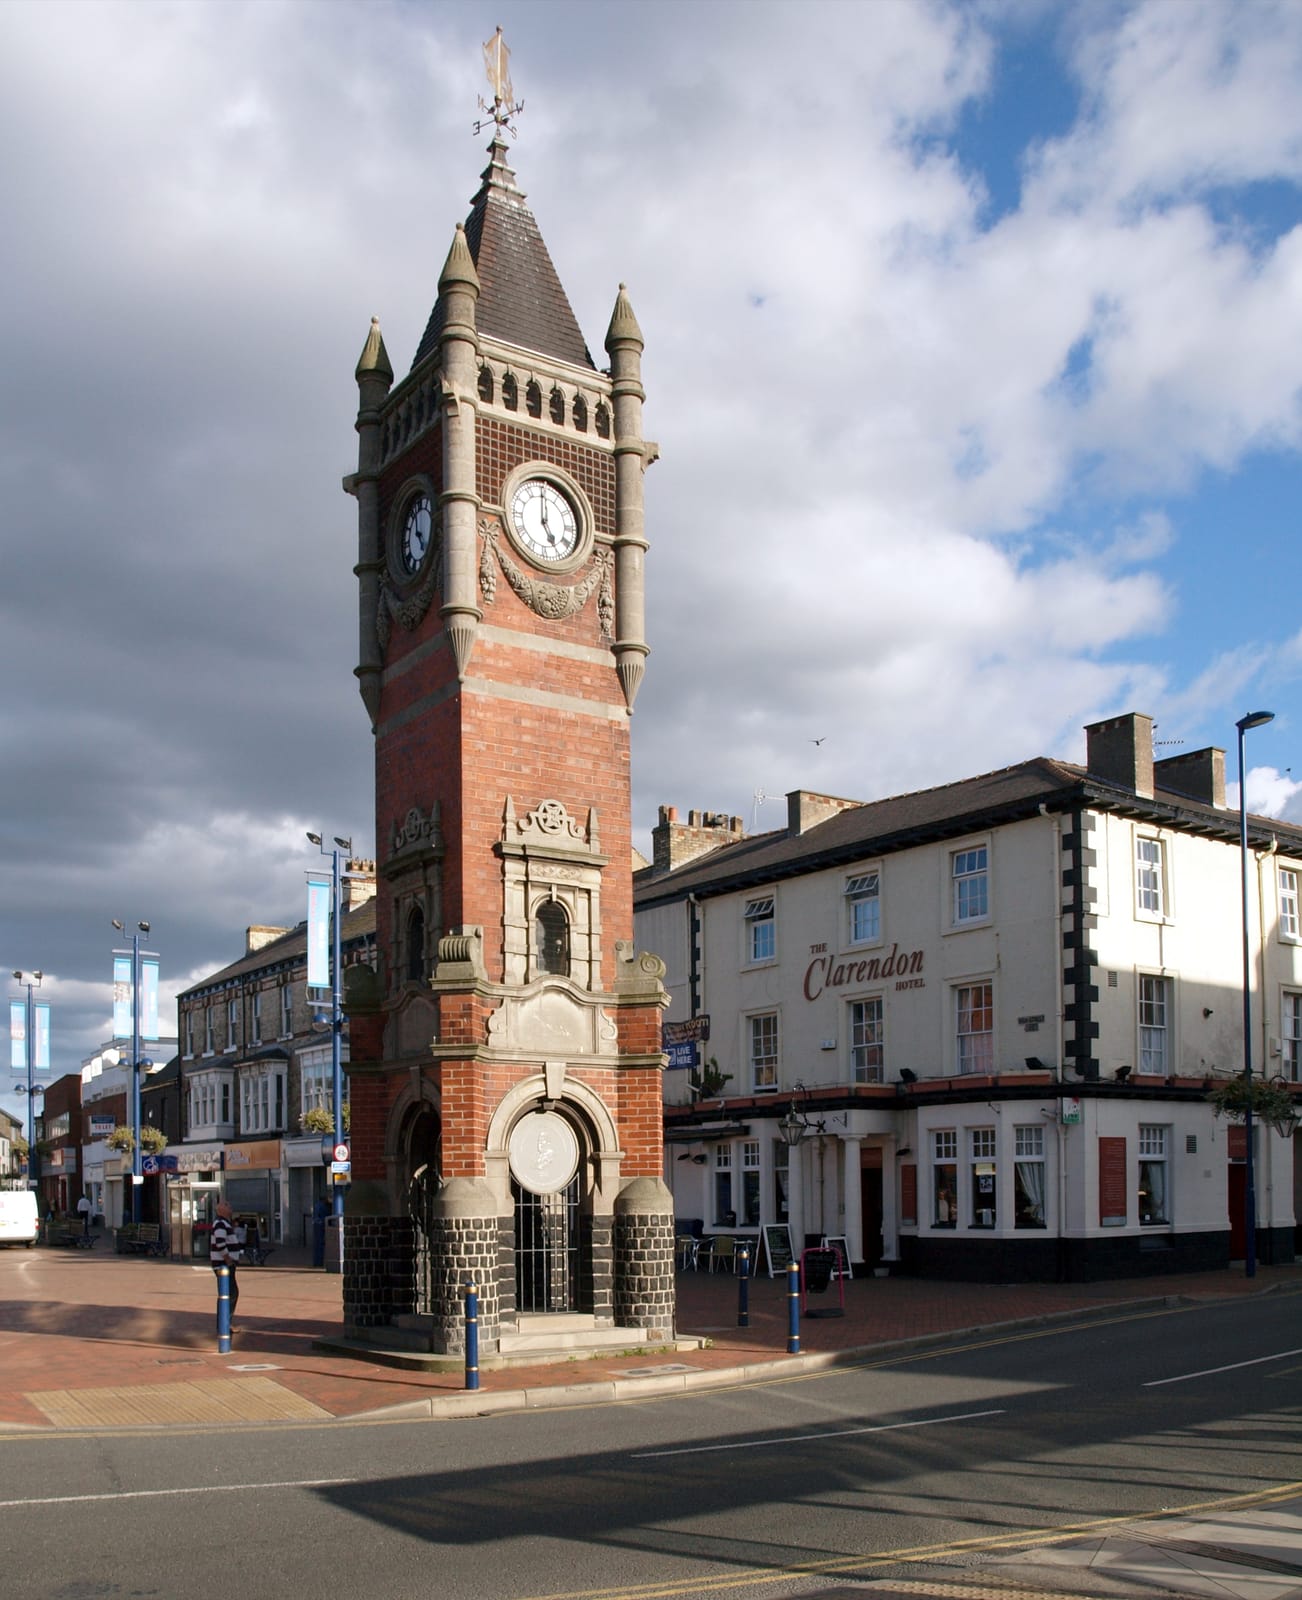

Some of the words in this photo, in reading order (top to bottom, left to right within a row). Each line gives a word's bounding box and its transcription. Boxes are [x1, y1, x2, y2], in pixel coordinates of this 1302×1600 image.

[809, 943, 828, 954] THE
[803, 943, 924, 1001] Clarendon
[895, 978, 925, 991] HOTEL
[677, 1046, 691, 1055] LIVE
[677, 1055, 692, 1065] HERE
